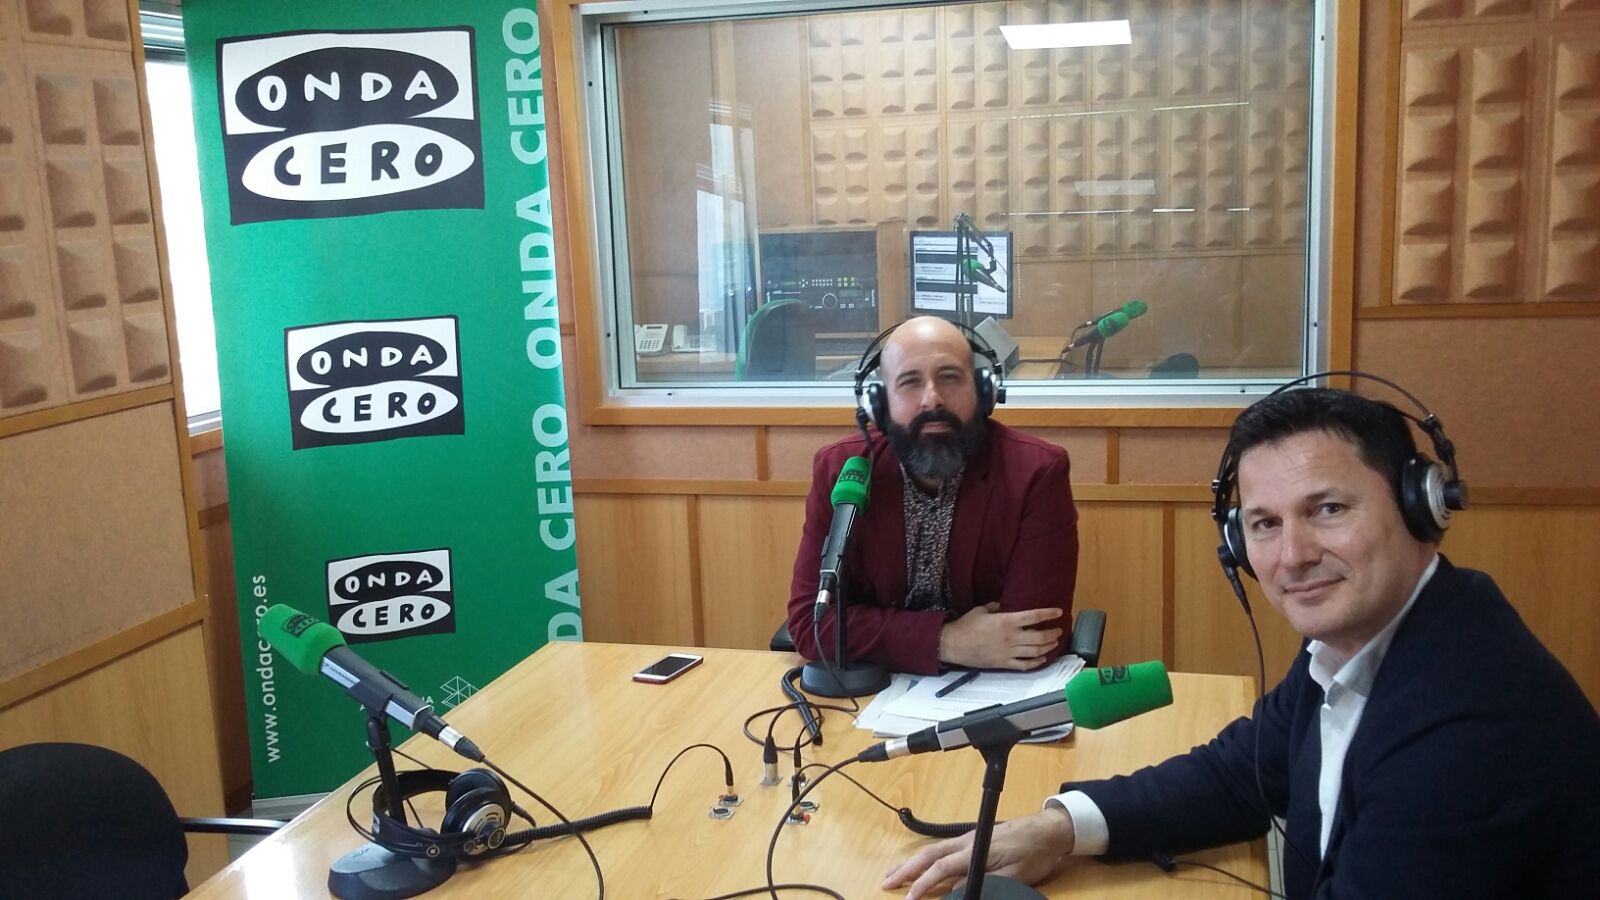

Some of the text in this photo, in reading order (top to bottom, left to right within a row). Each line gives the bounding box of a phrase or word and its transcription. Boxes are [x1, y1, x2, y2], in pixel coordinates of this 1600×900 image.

[257, 69, 438, 112] ONDA
[502, 7, 547, 165] CERO
[274, 140, 443, 186] CERO
[516, 186, 562, 370] ONDA
[310, 344, 434, 376] ONDA
[322, 391, 437, 424] CERO
[532, 403, 576, 551] CERO
[344, 569, 433, 593] ONDA
[352, 603, 435, 628] CERO
[253, 574, 281, 763] www.ondaco.es
